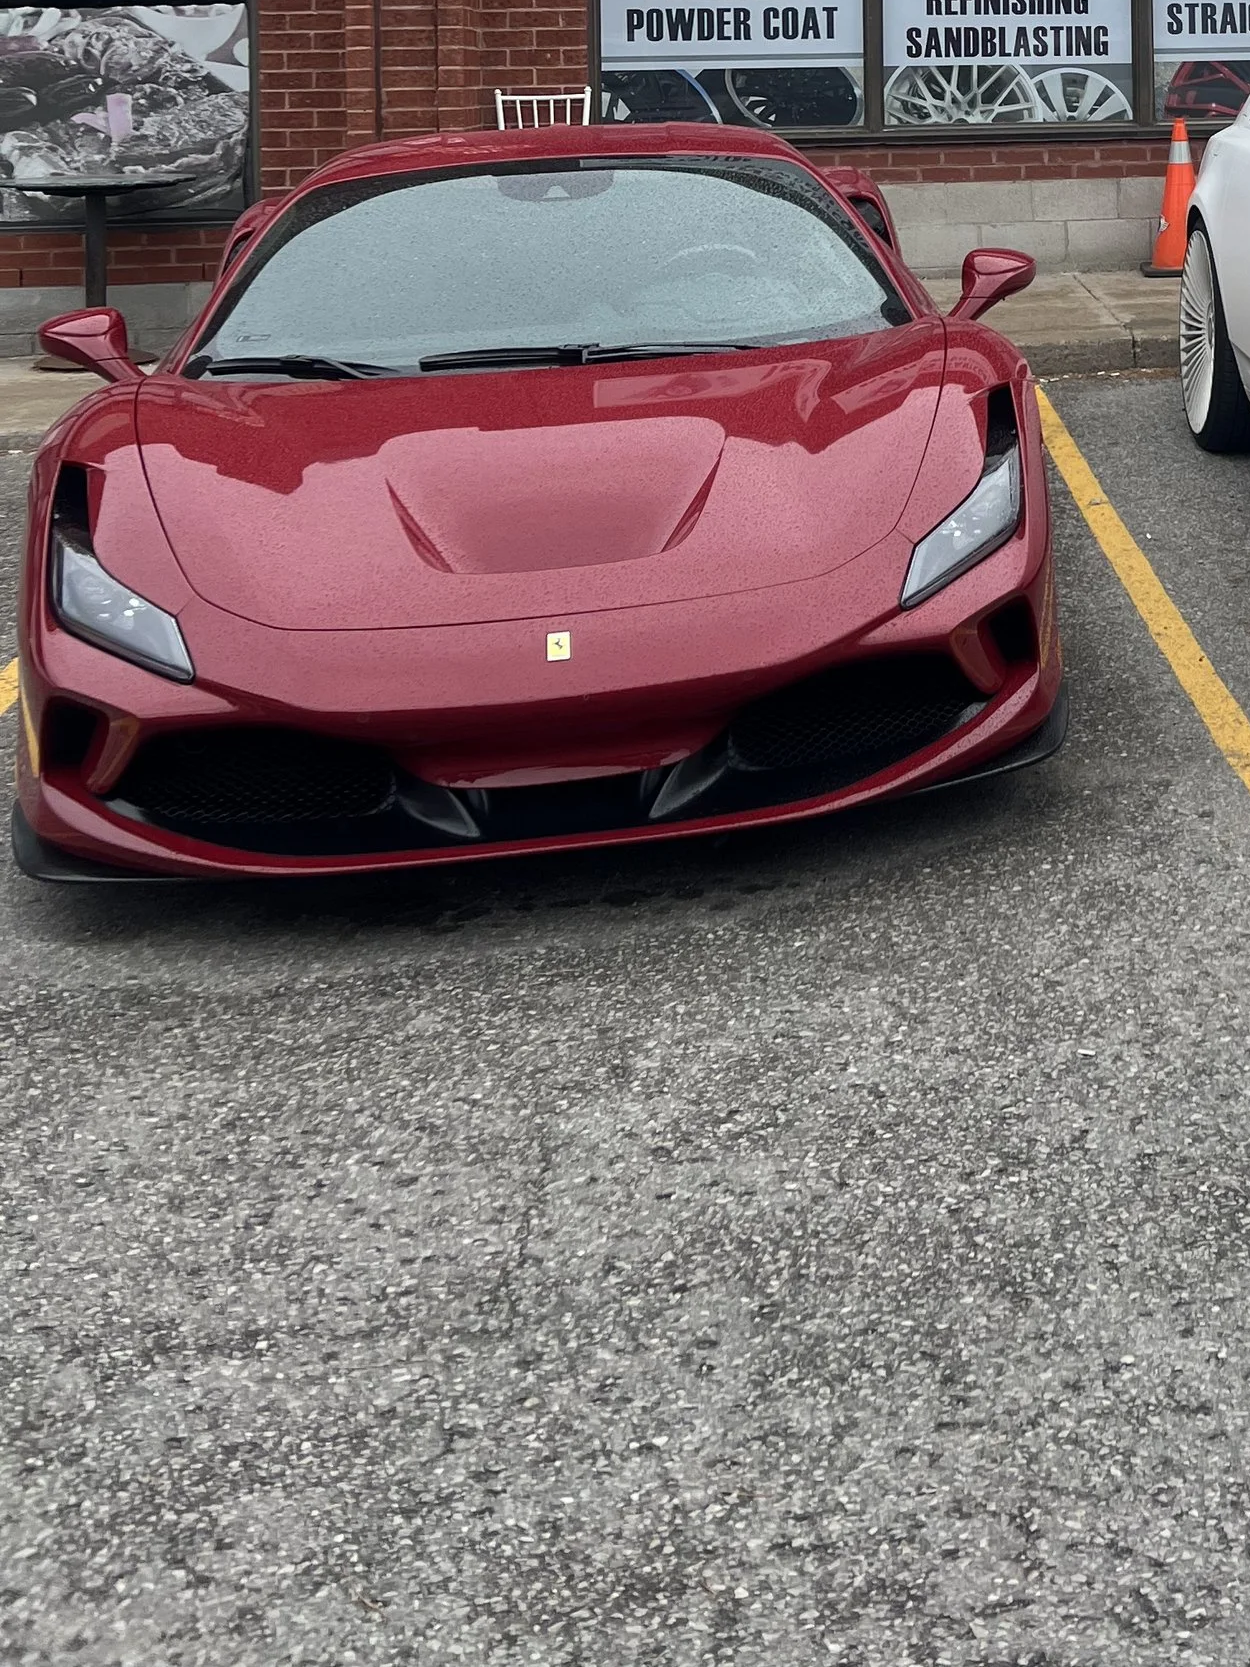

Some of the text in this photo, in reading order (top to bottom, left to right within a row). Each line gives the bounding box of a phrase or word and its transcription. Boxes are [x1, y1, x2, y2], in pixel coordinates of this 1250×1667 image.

[626, 6, 838, 42] POWDER COAT
[906, 25, 1109, 58] SANDBLASTING
